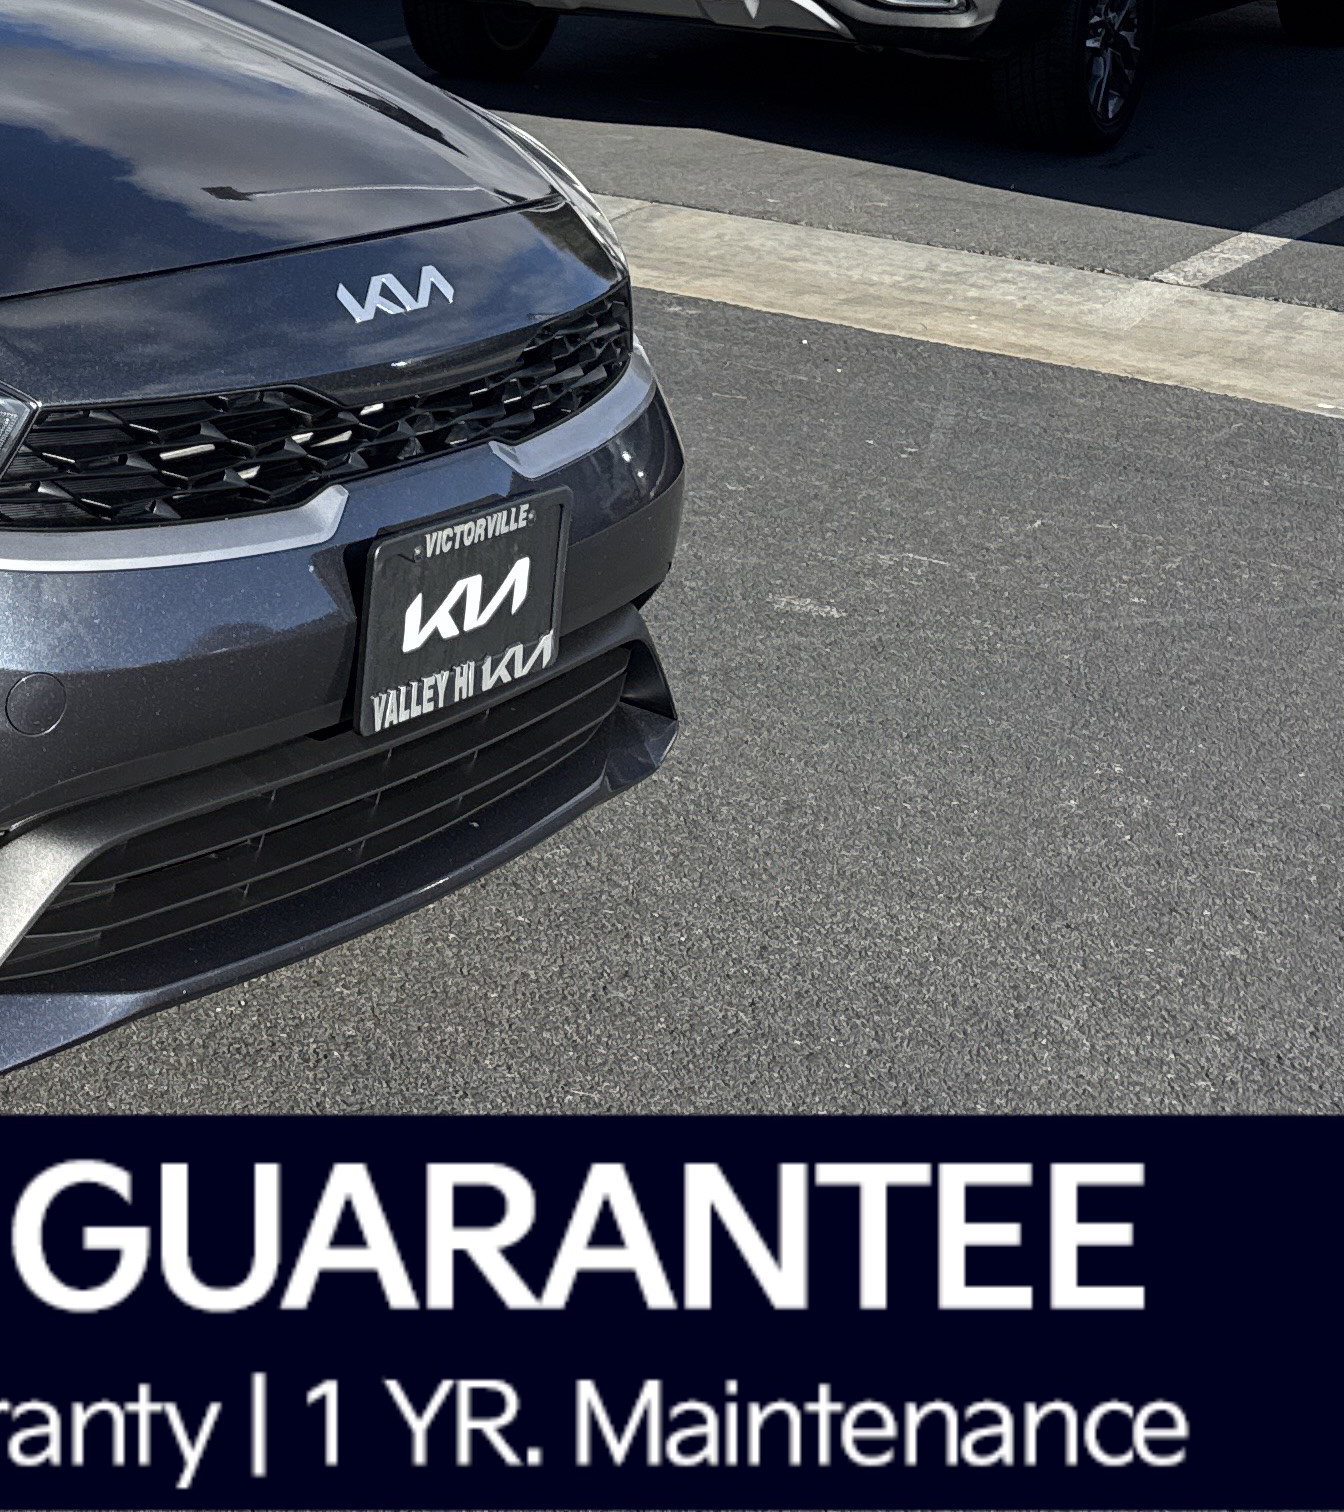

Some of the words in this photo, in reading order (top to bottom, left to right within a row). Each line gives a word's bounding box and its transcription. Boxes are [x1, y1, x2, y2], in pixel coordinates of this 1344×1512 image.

[337, 264, 455, 323] KIA
[424, 503, 530, 558] VICTORVILLE
[402, 556, 530, 654] KIA
[371, 670, 450, 733] VALLEY
[454, 660, 476, 703] HI
[481, 629, 554, 692] KIA
